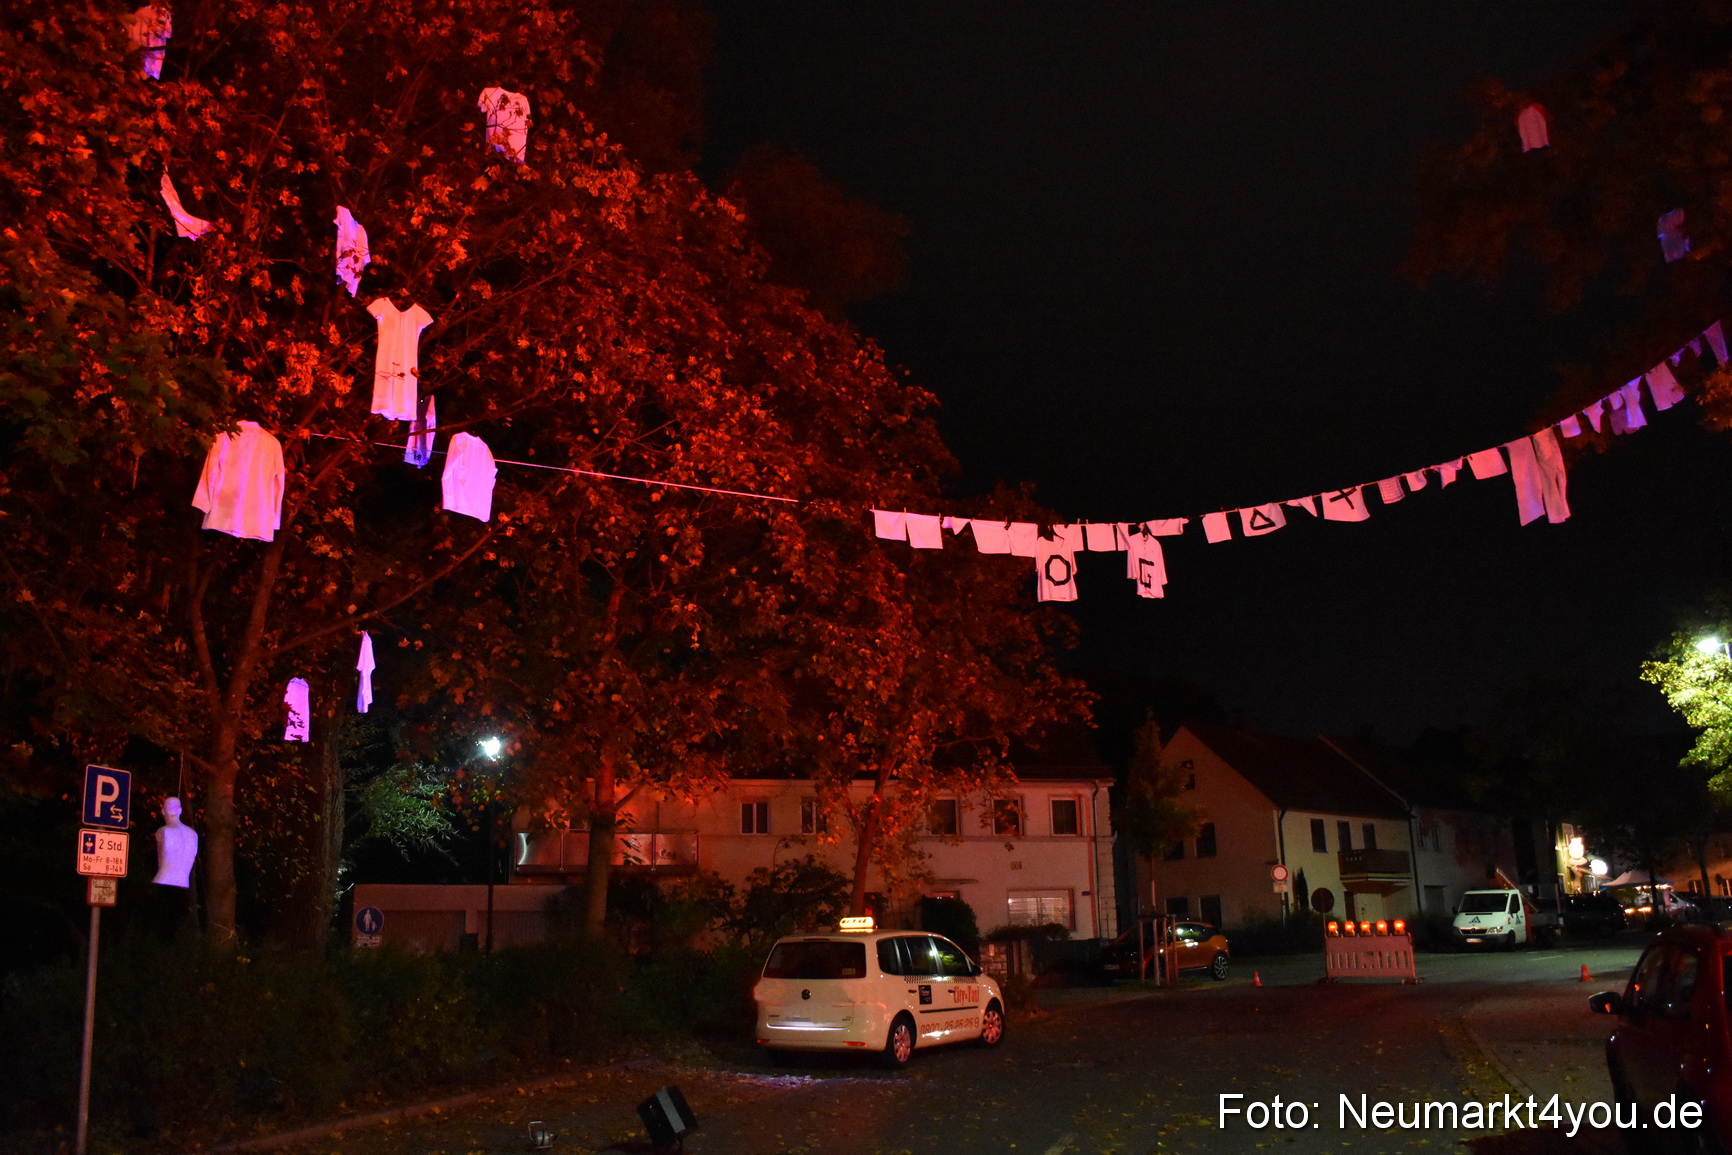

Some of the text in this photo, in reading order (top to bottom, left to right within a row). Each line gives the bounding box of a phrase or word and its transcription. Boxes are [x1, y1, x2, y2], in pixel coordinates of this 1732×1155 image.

[94, 774, 120, 818] P
[98, 838, 124, 852] 2 Std.
[83, 855, 103, 864] Mo-Fr
[83, 863, 91, 871] Sa
